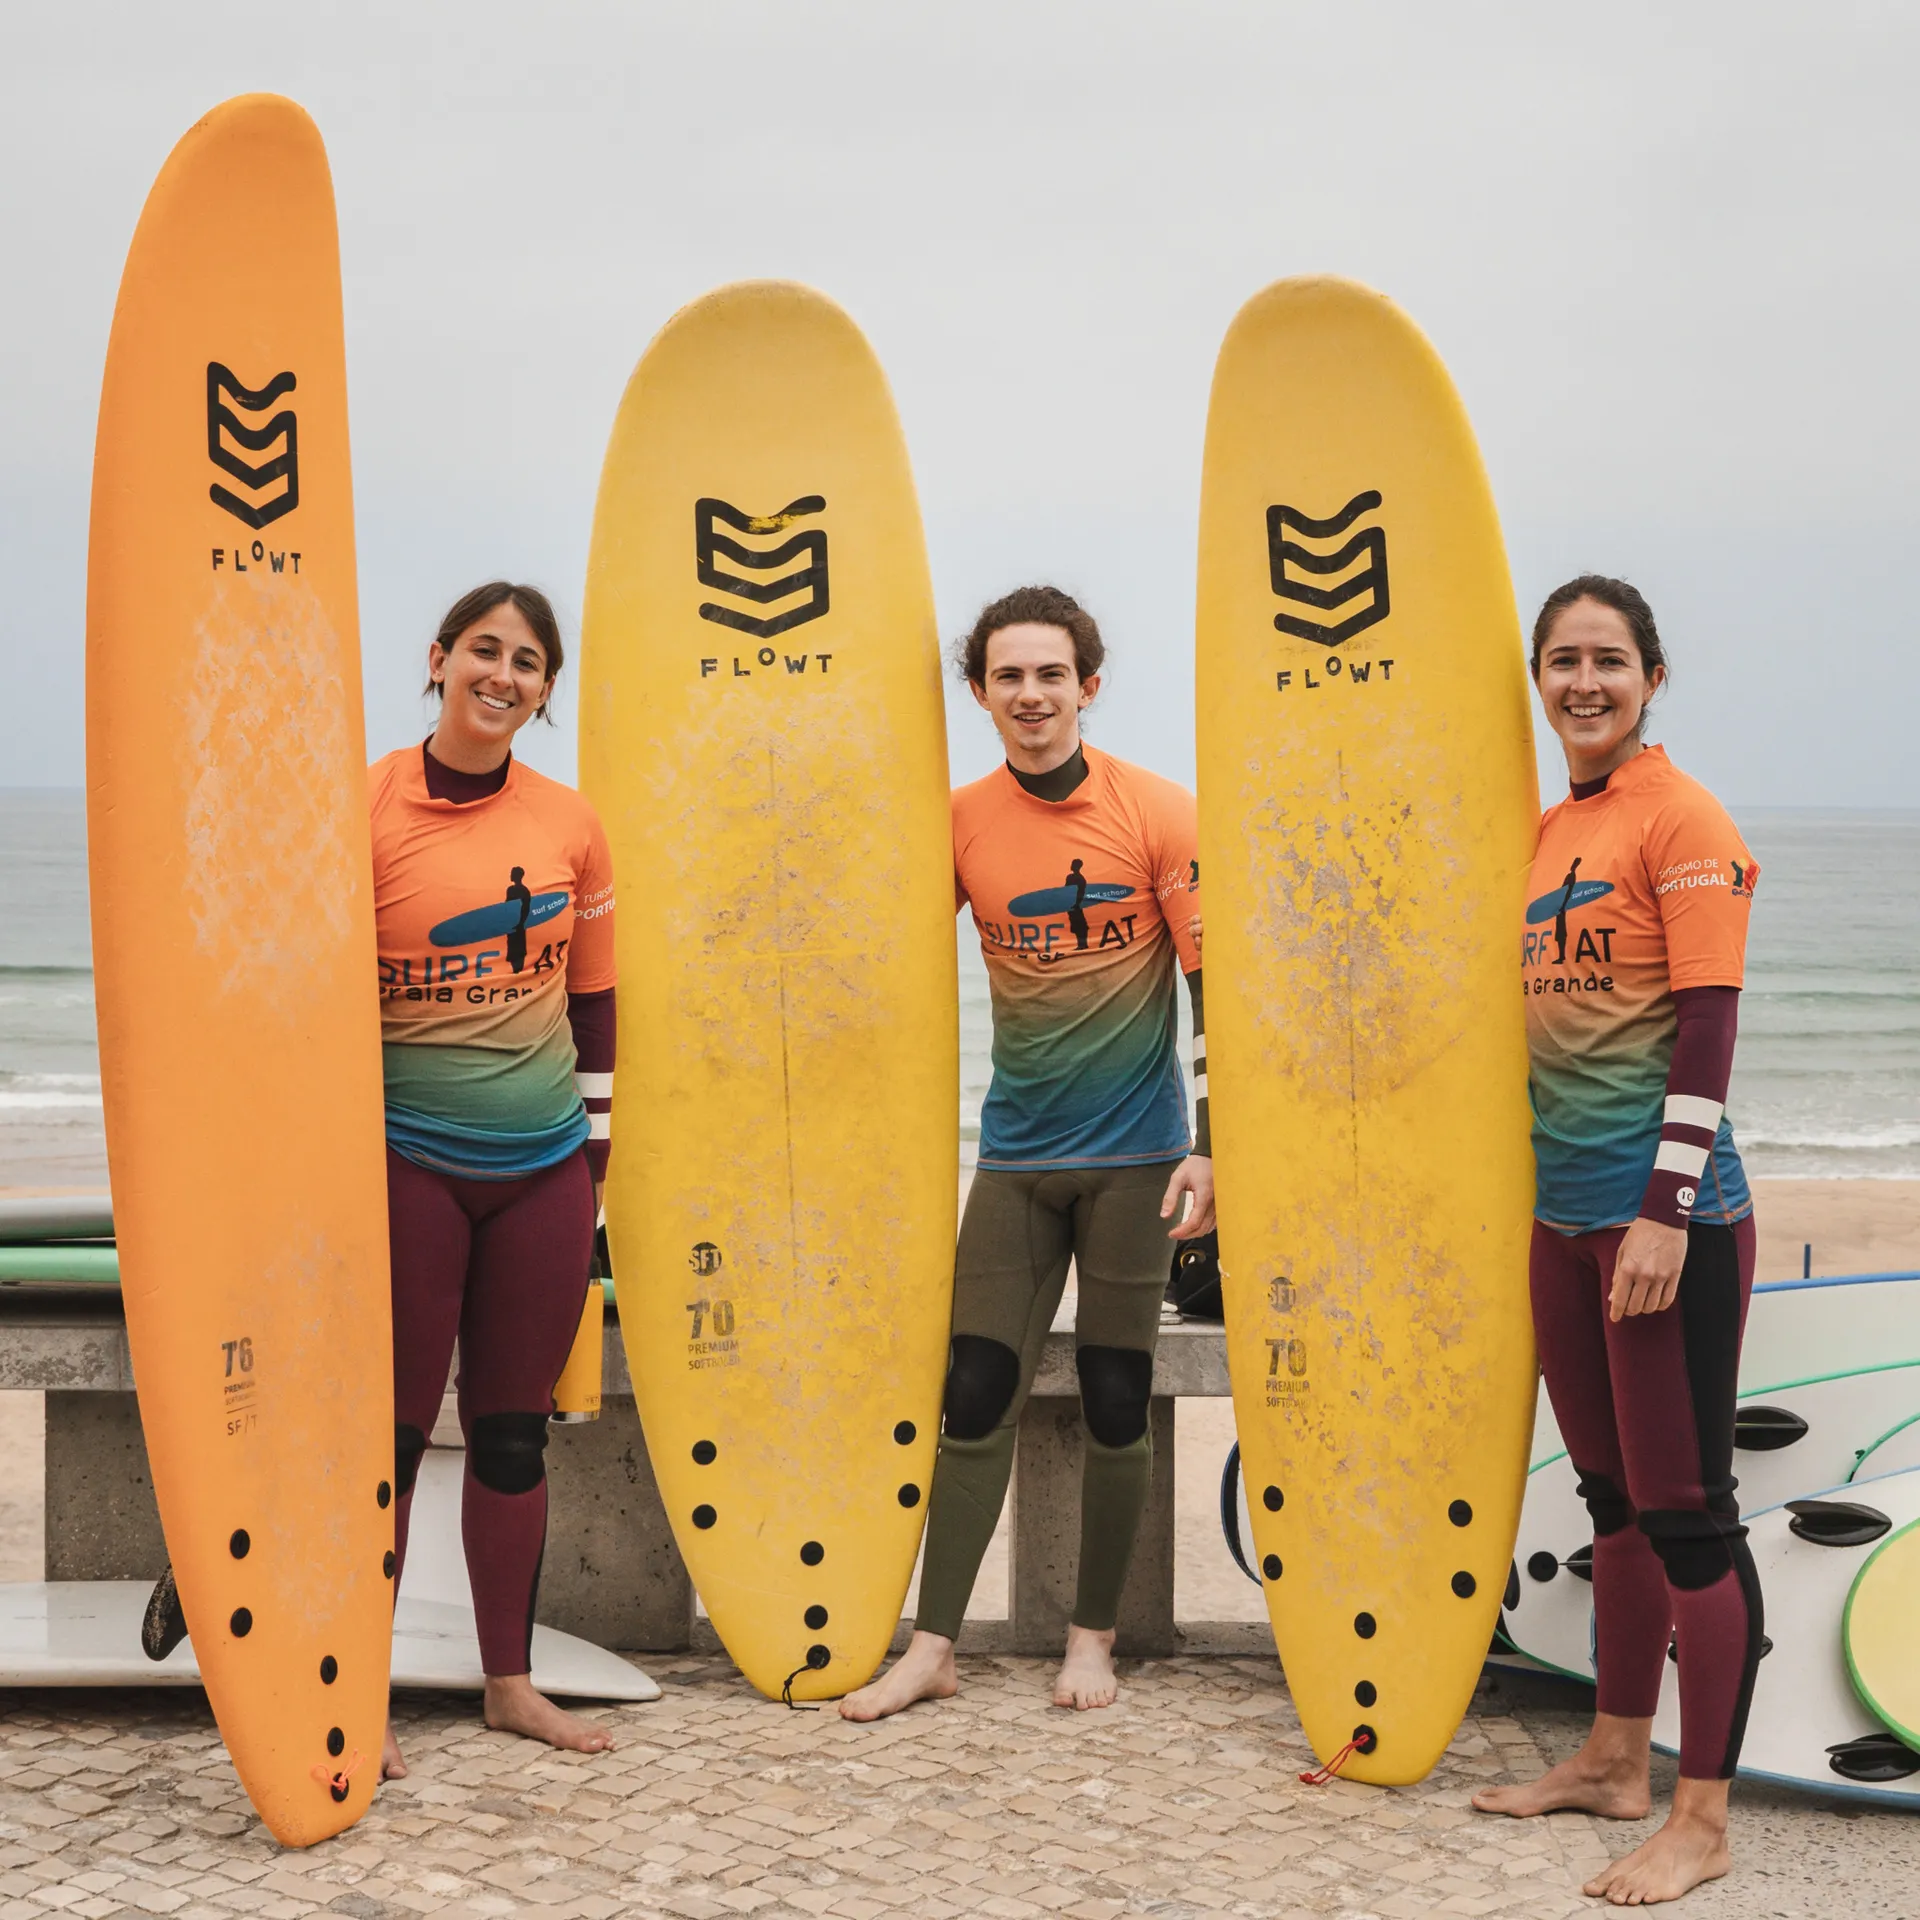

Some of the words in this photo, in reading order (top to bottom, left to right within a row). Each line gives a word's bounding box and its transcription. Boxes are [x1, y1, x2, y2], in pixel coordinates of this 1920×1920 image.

[212, 540, 301, 574] FLOWT
[701, 647, 832, 677] FLOWT
[1277, 656, 1394, 691] FLOWT
[1704, 859, 1719, 868] DE
[1102, 889, 1127, 897] school
[1656, 874, 1728, 894] PORTUGAL
[532, 905, 546, 916] surf
[574, 897, 616, 920] PORTU
[1099, 914, 1138, 950] AT
[1575, 928, 1616, 963] AT
[1533, 971, 1614, 995] Grande
[1682, 1191, 1693, 1201] 10
